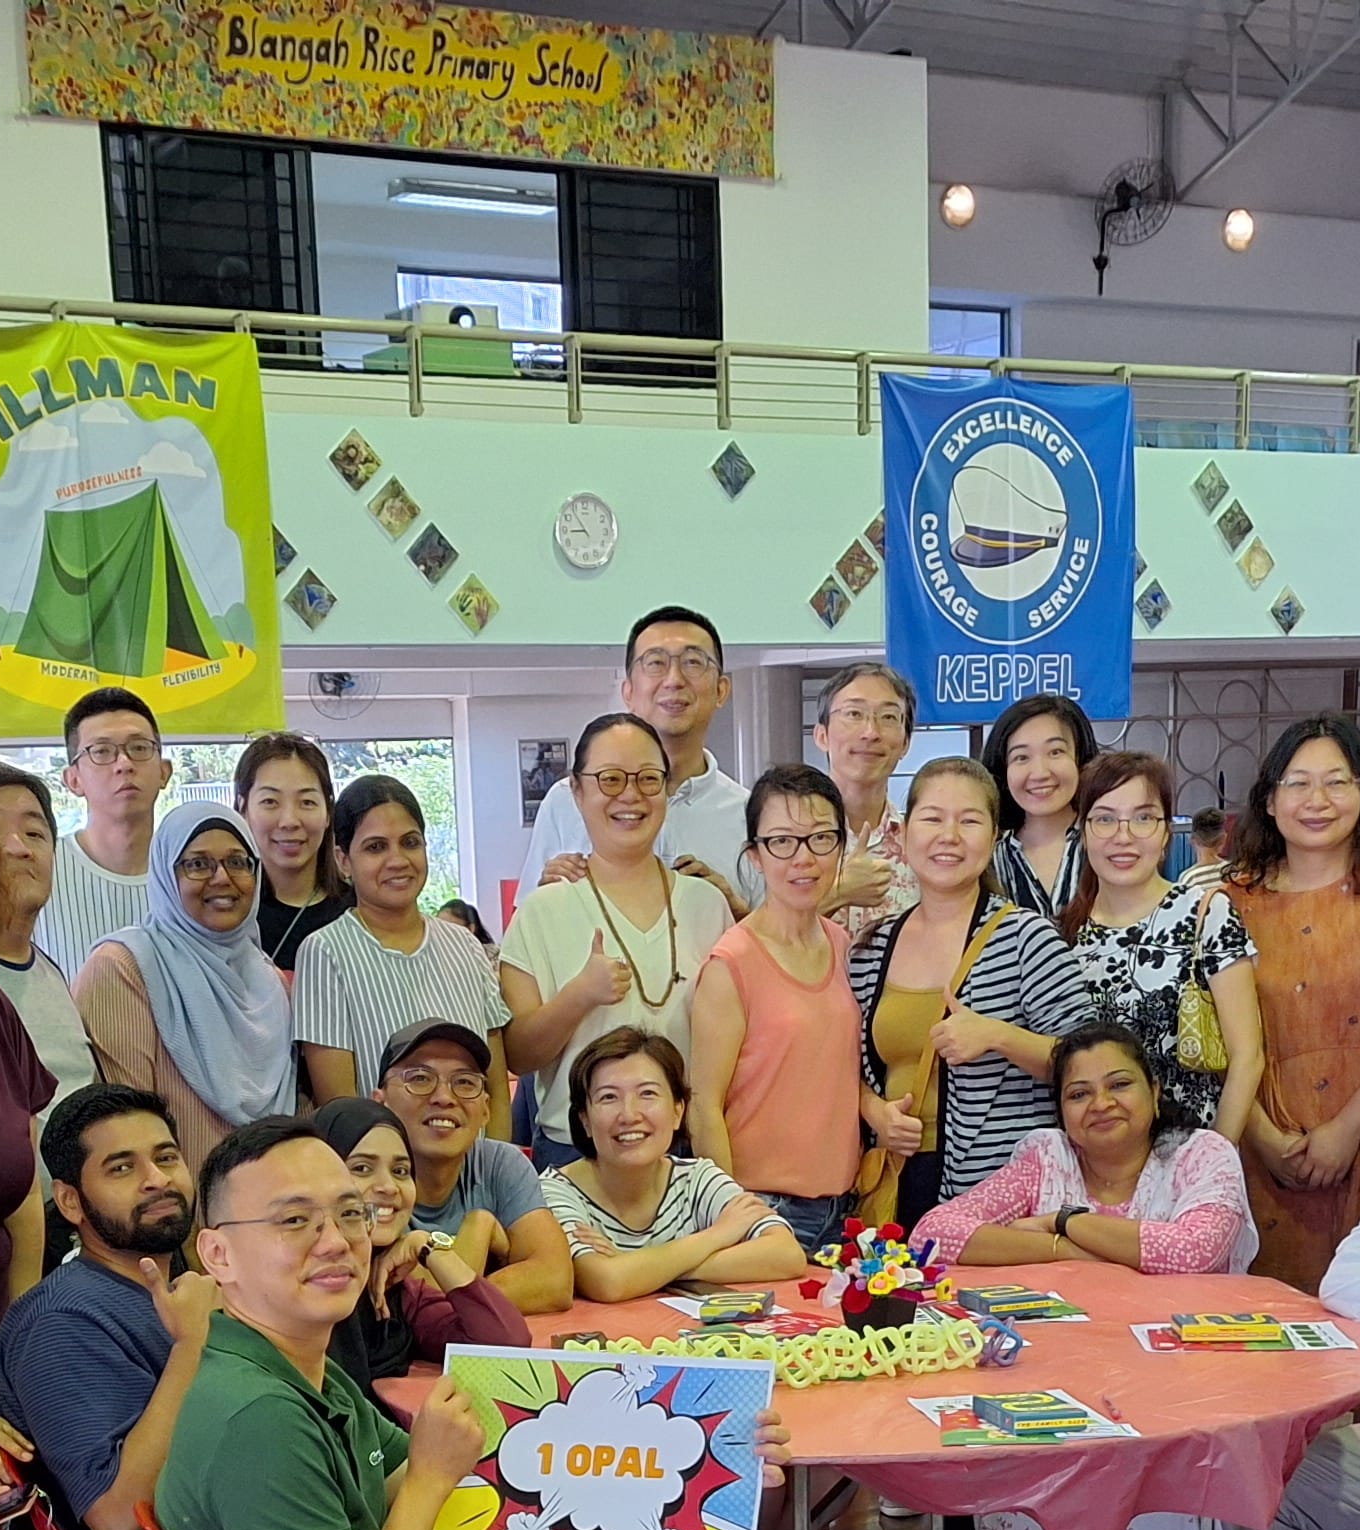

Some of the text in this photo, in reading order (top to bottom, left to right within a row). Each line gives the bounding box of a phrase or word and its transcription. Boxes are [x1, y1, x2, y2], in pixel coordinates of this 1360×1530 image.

[225, 15, 609, 100] Blangah Rise Primary School
[942, 410, 1074, 467] EXCELLENCE
[920, 512, 979, 627] COURAGE
[1028, 536, 1090, 629] SERVICE
[162, 662, 222, 688] FLEXIBILITY
[937, 653, 1081, 703] KEPPEL
[537, 1443, 665, 1479] 1 OPAL
